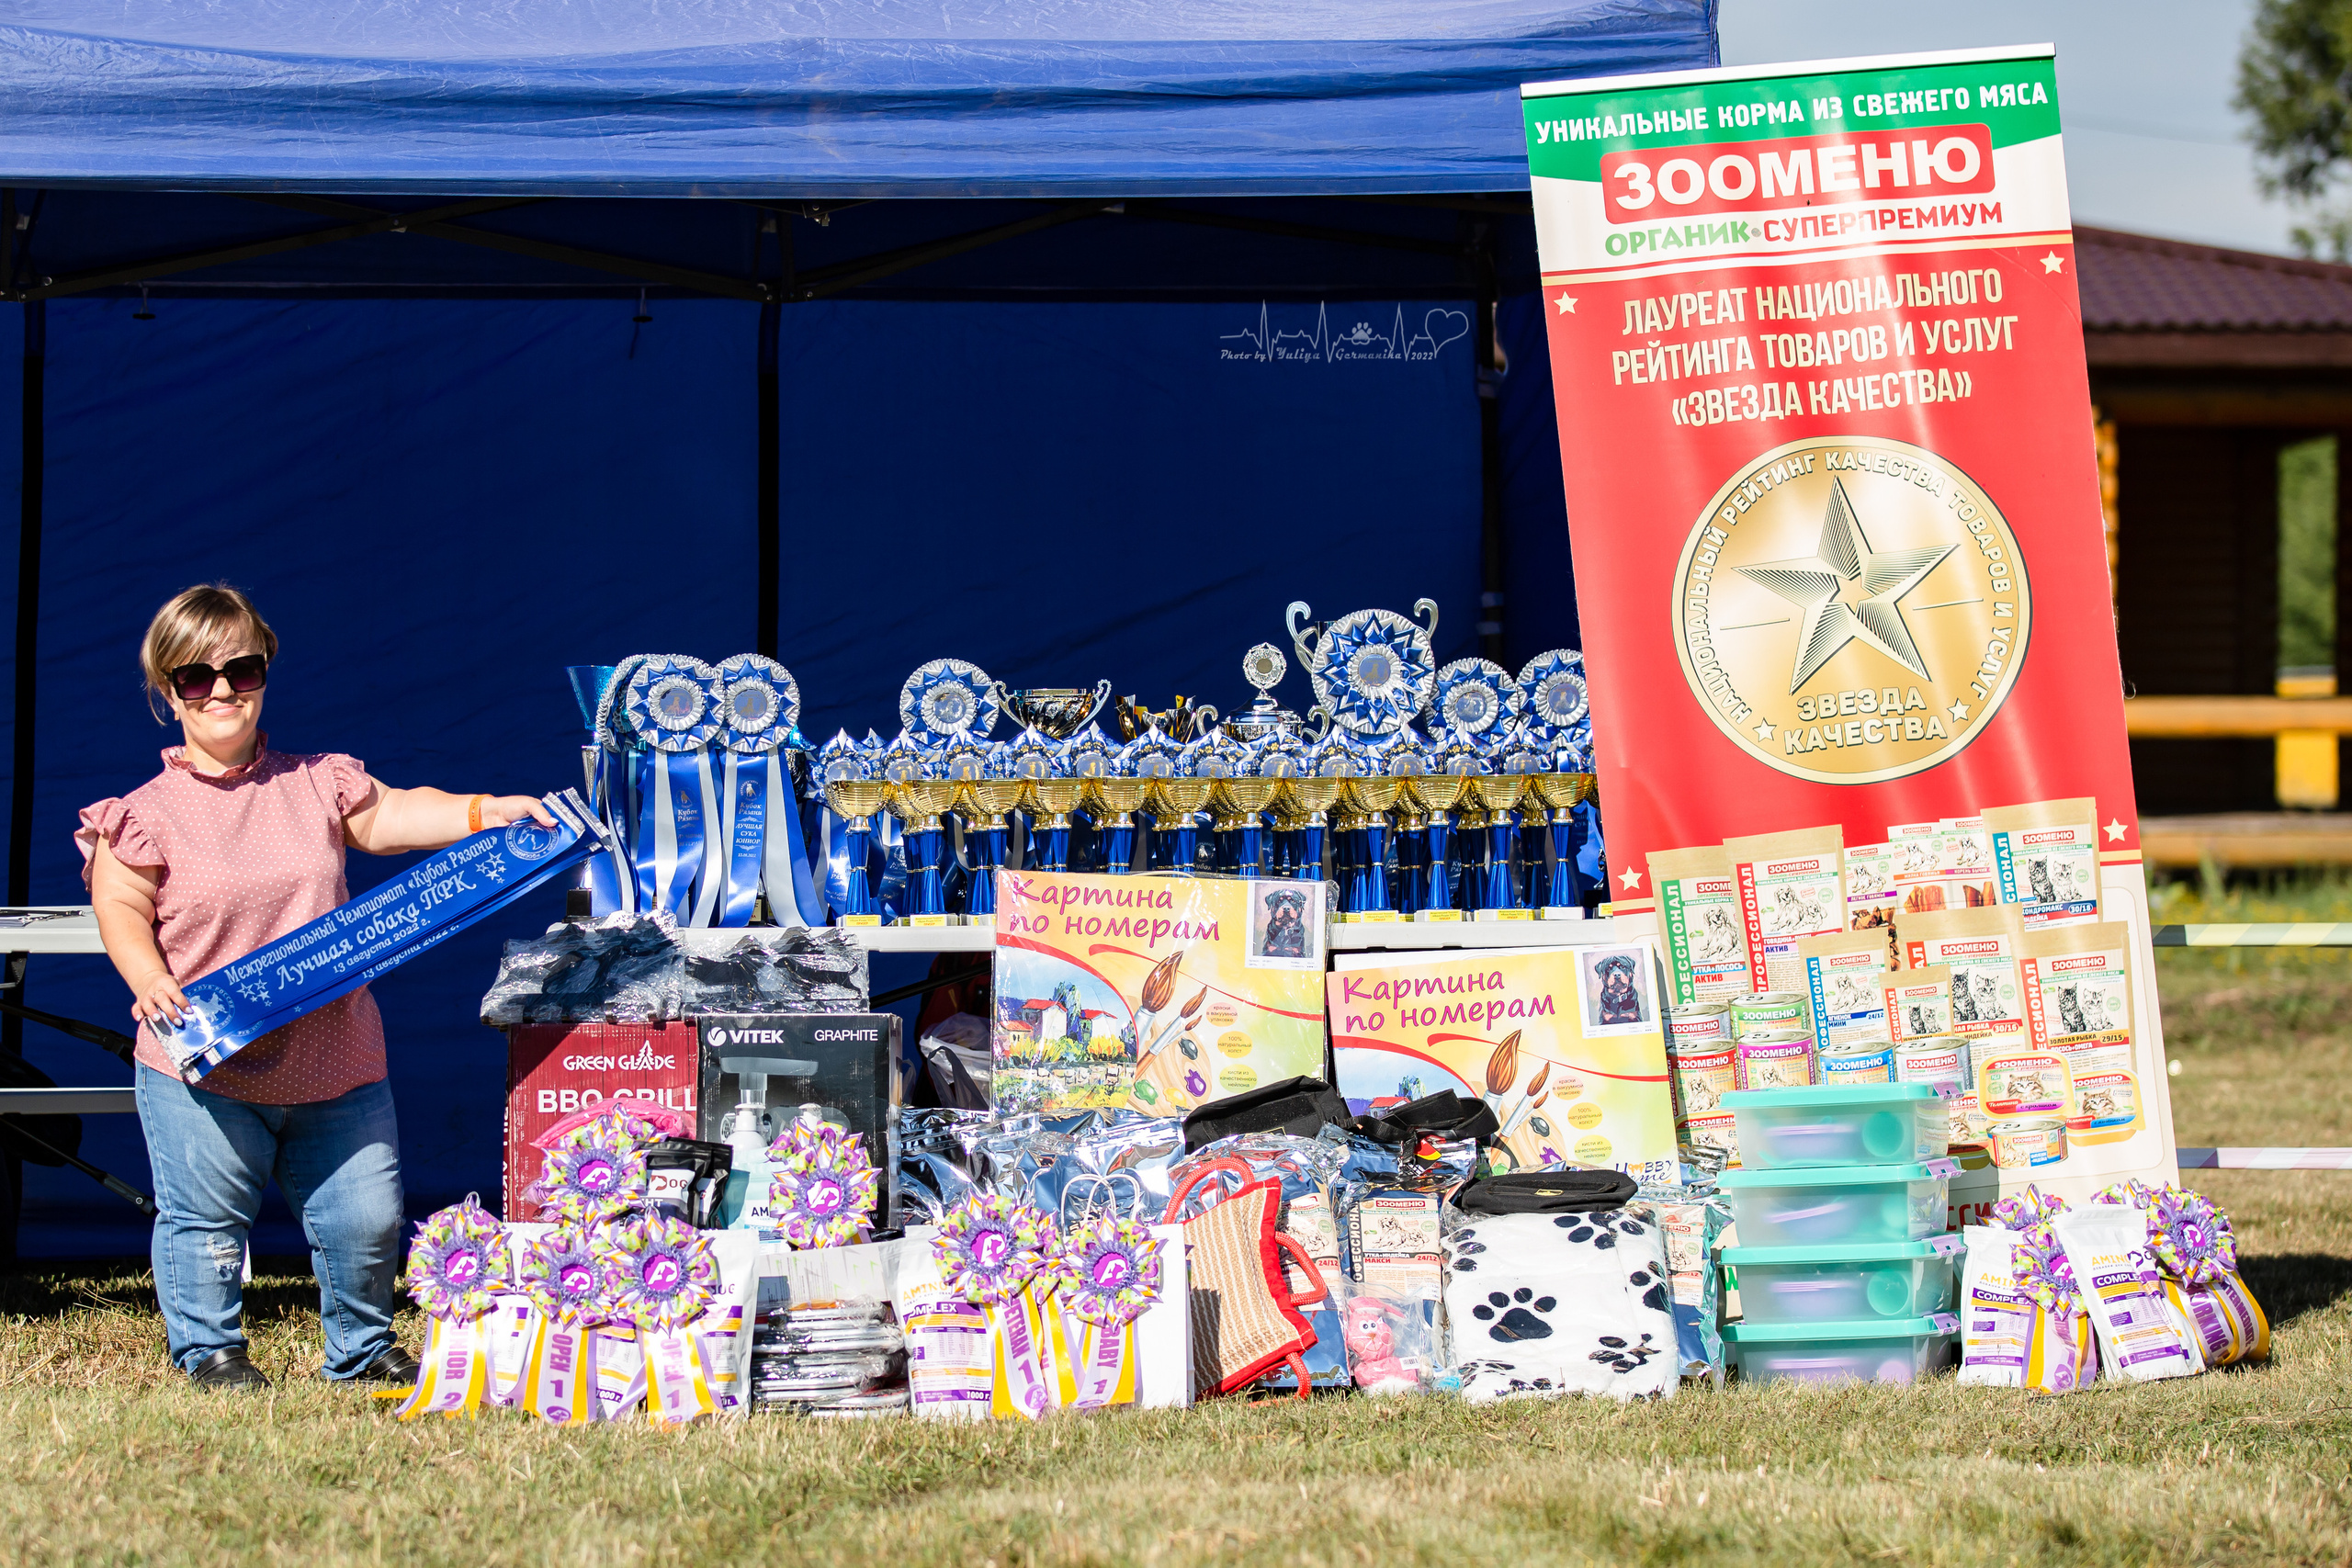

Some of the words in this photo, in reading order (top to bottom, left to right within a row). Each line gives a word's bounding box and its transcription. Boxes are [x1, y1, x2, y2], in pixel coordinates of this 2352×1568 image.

[1535, 107, 1709, 145] УНИКАЛЬНЫЕ
[1718, 99, 1804, 129] КОРМА
[1813, 96, 1844, 120] ИЗ
[1852, 85, 1970, 118] СВЕЖЕГО
[1980, 81, 2048, 108] МЯСА
[1612, 136, 1982, 211] ЗООМЕНЮ
[1605, 220, 1750, 256] ОРГАНИК
[1763, 202, 2003, 243] СУПЕРПРЕМИУМ
[1622, 287, 1748, 336] ЛАУРЕАТ
[1757, 267, 2003, 322] НАЦИОНАЛЬНОГО
[1611, 335, 1756, 386] РЕЙТИНГА
[1760, 324, 1888, 368] ТОВАРОВ
[1895, 321, 1916, 357] И
[1926, 315, 2018, 356] УСЛУГ
[1671, 381, 1804, 428] «ЗВЕЗДА
[1809, 368, 1973, 415] КАЧЕСТВА»
[1721, 454, 1815, 525] РЕЙТИНГ
[1825, 451, 1946, 497] КАЧЕСТВА
[1949, 491, 2014, 594] ТОВАРОВ
[1689, 525, 1752, 725] НАЦИОНАЛЬНЫЙ
[1994, 601, 2013, 618] И
[1971, 624, 2013, 701] УСЛУГ
[1797, 686, 1927, 721] ЗВЕЗДА
[1783, 716, 1947, 754] КАЧЕСТВА
[2024, 831, 2074, 843] ЗООМЕНЮ
[1770, 861, 1818, 874] ЗООМЕНЮ
[1997, 838, 2016, 902] СИОНАЛ
[1012, 876, 1174, 916] Картина
[1698, 883, 1732, 892] ЗООМЕ
[224, 916, 337, 986] Межрегиональный
[334, 881, 408, 927] Чемпионат
[408, 862, 451, 891] «Кубок
[447, 835, 498, 871] Рязани»
[2070, 905, 2091, 913] 30/18
[277, 937, 354, 990] Лучшая
[356, 902, 420, 944] собака
[420, 870, 477, 910] ПРК
[1010, 914, 1050, 937] по
[1065, 914, 1221, 949] номерам
[1667, 885, 1694, 1004] ФЕССИОНАЛ
[333, 963, 346, 974] 13
[346, 937, 392, 967] августа
[393, 923, 420, 942] 2022
[1831, 955, 1870, 965] ЗООМЕНЮ
[1942, 942, 1997, 954] ЗООМЕНЮ
[2053, 957, 2104, 970] ЗООМЕНЮ
[1343, 969, 1506, 1010] Картина
[1695, 974, 1724, 984] АКТИВ
[1345, 1010, 1385, 1034] по
[1401, 994, 1555, 1032] номерам
[1743, 1009, 1796, 1020] ЗООМЕНЮ
[1810, 961, 1828, 1045] ОФЕССИОНАЛ
[1888, 991, 1901, 1045] ЕССИОНАЛ
[2025, 963, 2048, 1050] ЕССИОНАЛ
[729, 1029, 785, 1044] VITEK
[814, 1029, 878, 1042] GRAPHITE
[1670, 1021, 1718, 1032] ЗООМЕНЮ
[1967, 1022, 1989, 1031] РЫБКА
[1995, 1024, 2017, 1032] 30/16
[2102, 1034, 2122, 1043] 29/15
[563, 1055, 615, 1073] GREEN
[618, 1041, 675, 1072] GLADE
[1677, 1056, 1729, 1068] ЗООМЕНЮ
[1748, 1046, 1803, 1057] ЗООМЕНЮ
[1831, 1057, 1883, 1070] ЗООМЕНЮ
[1907, 1055, 1957, 1067] ЗООМЕНЮ
[1995, 1058, 2052, 1068] ЗООМЕНЮ
[1349, 1202, 1363, 1281] ОФЕССИОНА
[1981, 1273, 2018, 1287] AMIN
[2097, 1273, 2141, 1286] COMPLE
[910, 1303, 957, 1316] OMPLEX
[549, 1333, 573, 1373] OPEN
[660, 1337, 685, 1382] OPEN
[1097, 1324, 1120, 1368] BABY
[1018, 1359, 1035, 1384] 1
[1093, 1379, 1107, 1394] 1
[550, 1379, 563, 1398] 1
[666, 1389, 680, 1409] 1
[967, 1391, 984, 1399] 1000
